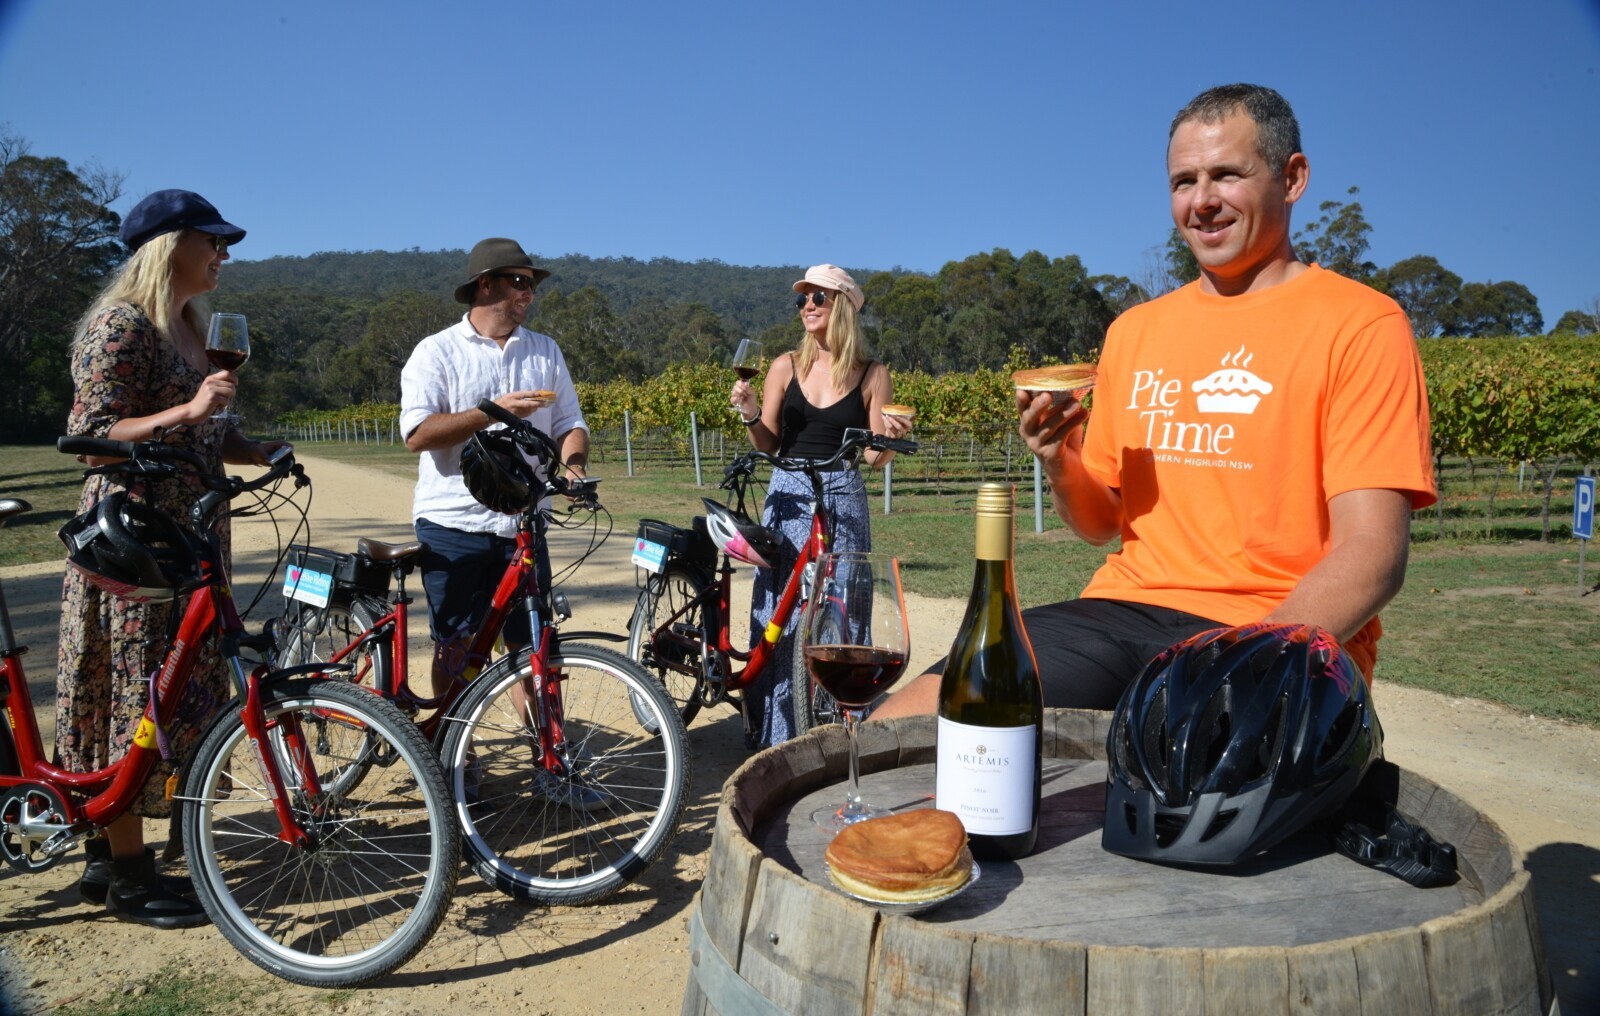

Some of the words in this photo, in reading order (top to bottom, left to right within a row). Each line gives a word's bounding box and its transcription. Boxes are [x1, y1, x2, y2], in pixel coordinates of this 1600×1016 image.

[1126, 368, 1182, 410] Pie
[1139, 409, 1235, 455] Time
[1229, 460, 1254, 470] NSW
[1577, 484, 1592, 529] P
[956, 753, 1010, 766] ARTEMIS
[960, 804, 980, 812] PINOT
[982, 806, 1000, 814] NOIR
